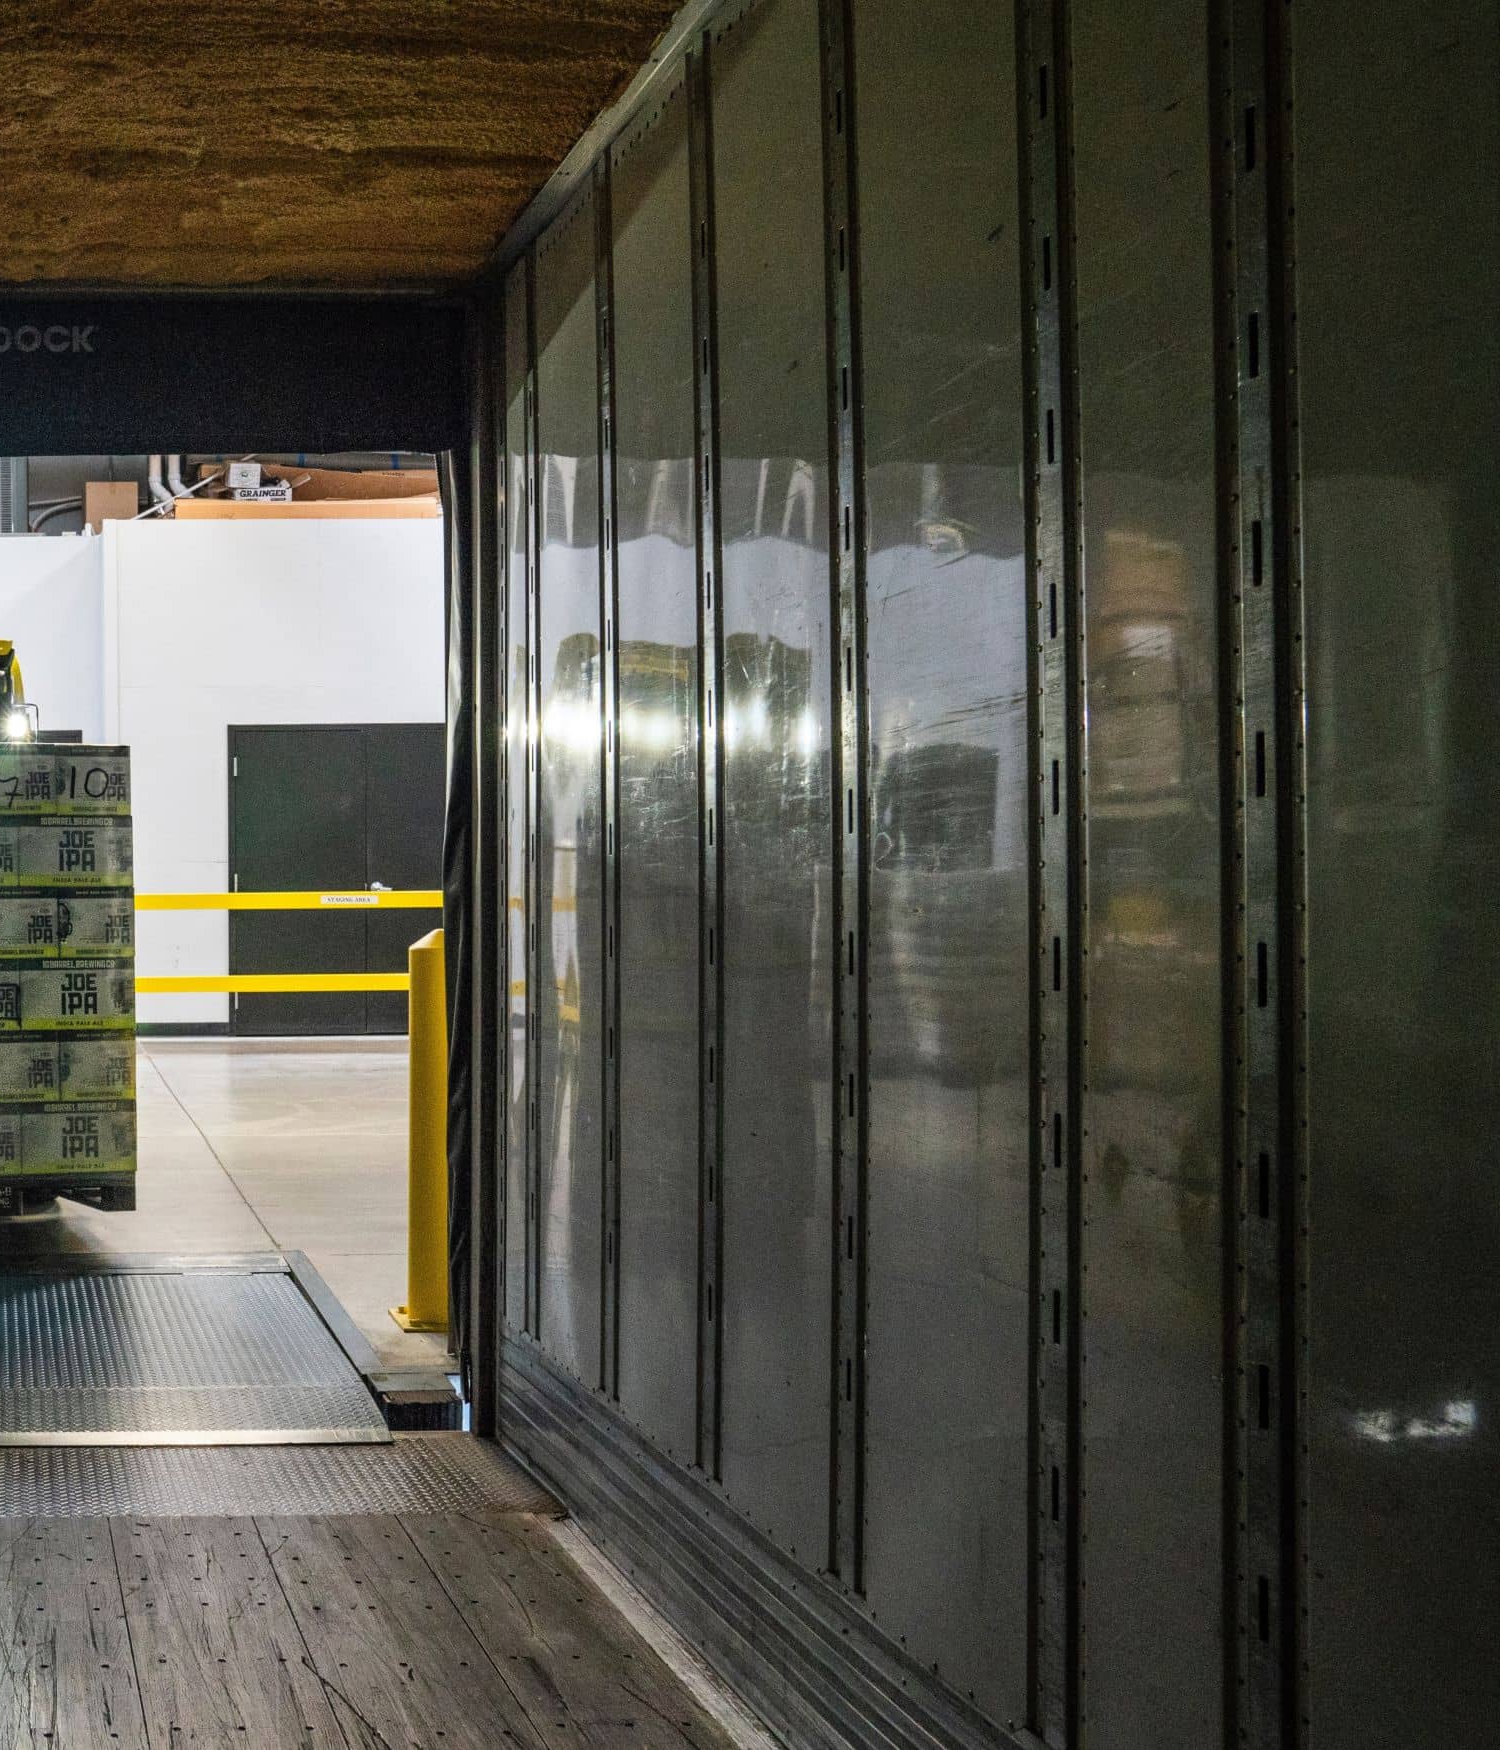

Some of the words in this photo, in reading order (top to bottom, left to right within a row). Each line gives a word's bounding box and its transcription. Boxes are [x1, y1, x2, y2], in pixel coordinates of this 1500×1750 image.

[239, 489, 286, 498] GRAINGER
[25, 772, 50, 785] JOE
[25, 785, 51, 800] IPA
[59, 831, 95, 848] JOE
[59, 849, 95, 871] IPA
[27, 915, 52, 927] JOE
[105, 915, 130, 927] JOE
[27, 928, 53, 944] IPA
[105, 928, 130, 943] IPA
[61, 973, 97, 991] JOE
[61, 992, 98, 1015] IPA
[28, 1058, 53, 1071] JOE
[28, 1072, 54, 1088] IPA
[62, 1116, 98, 1134] JOE
[62, 1135, 99, 1158] IPA
